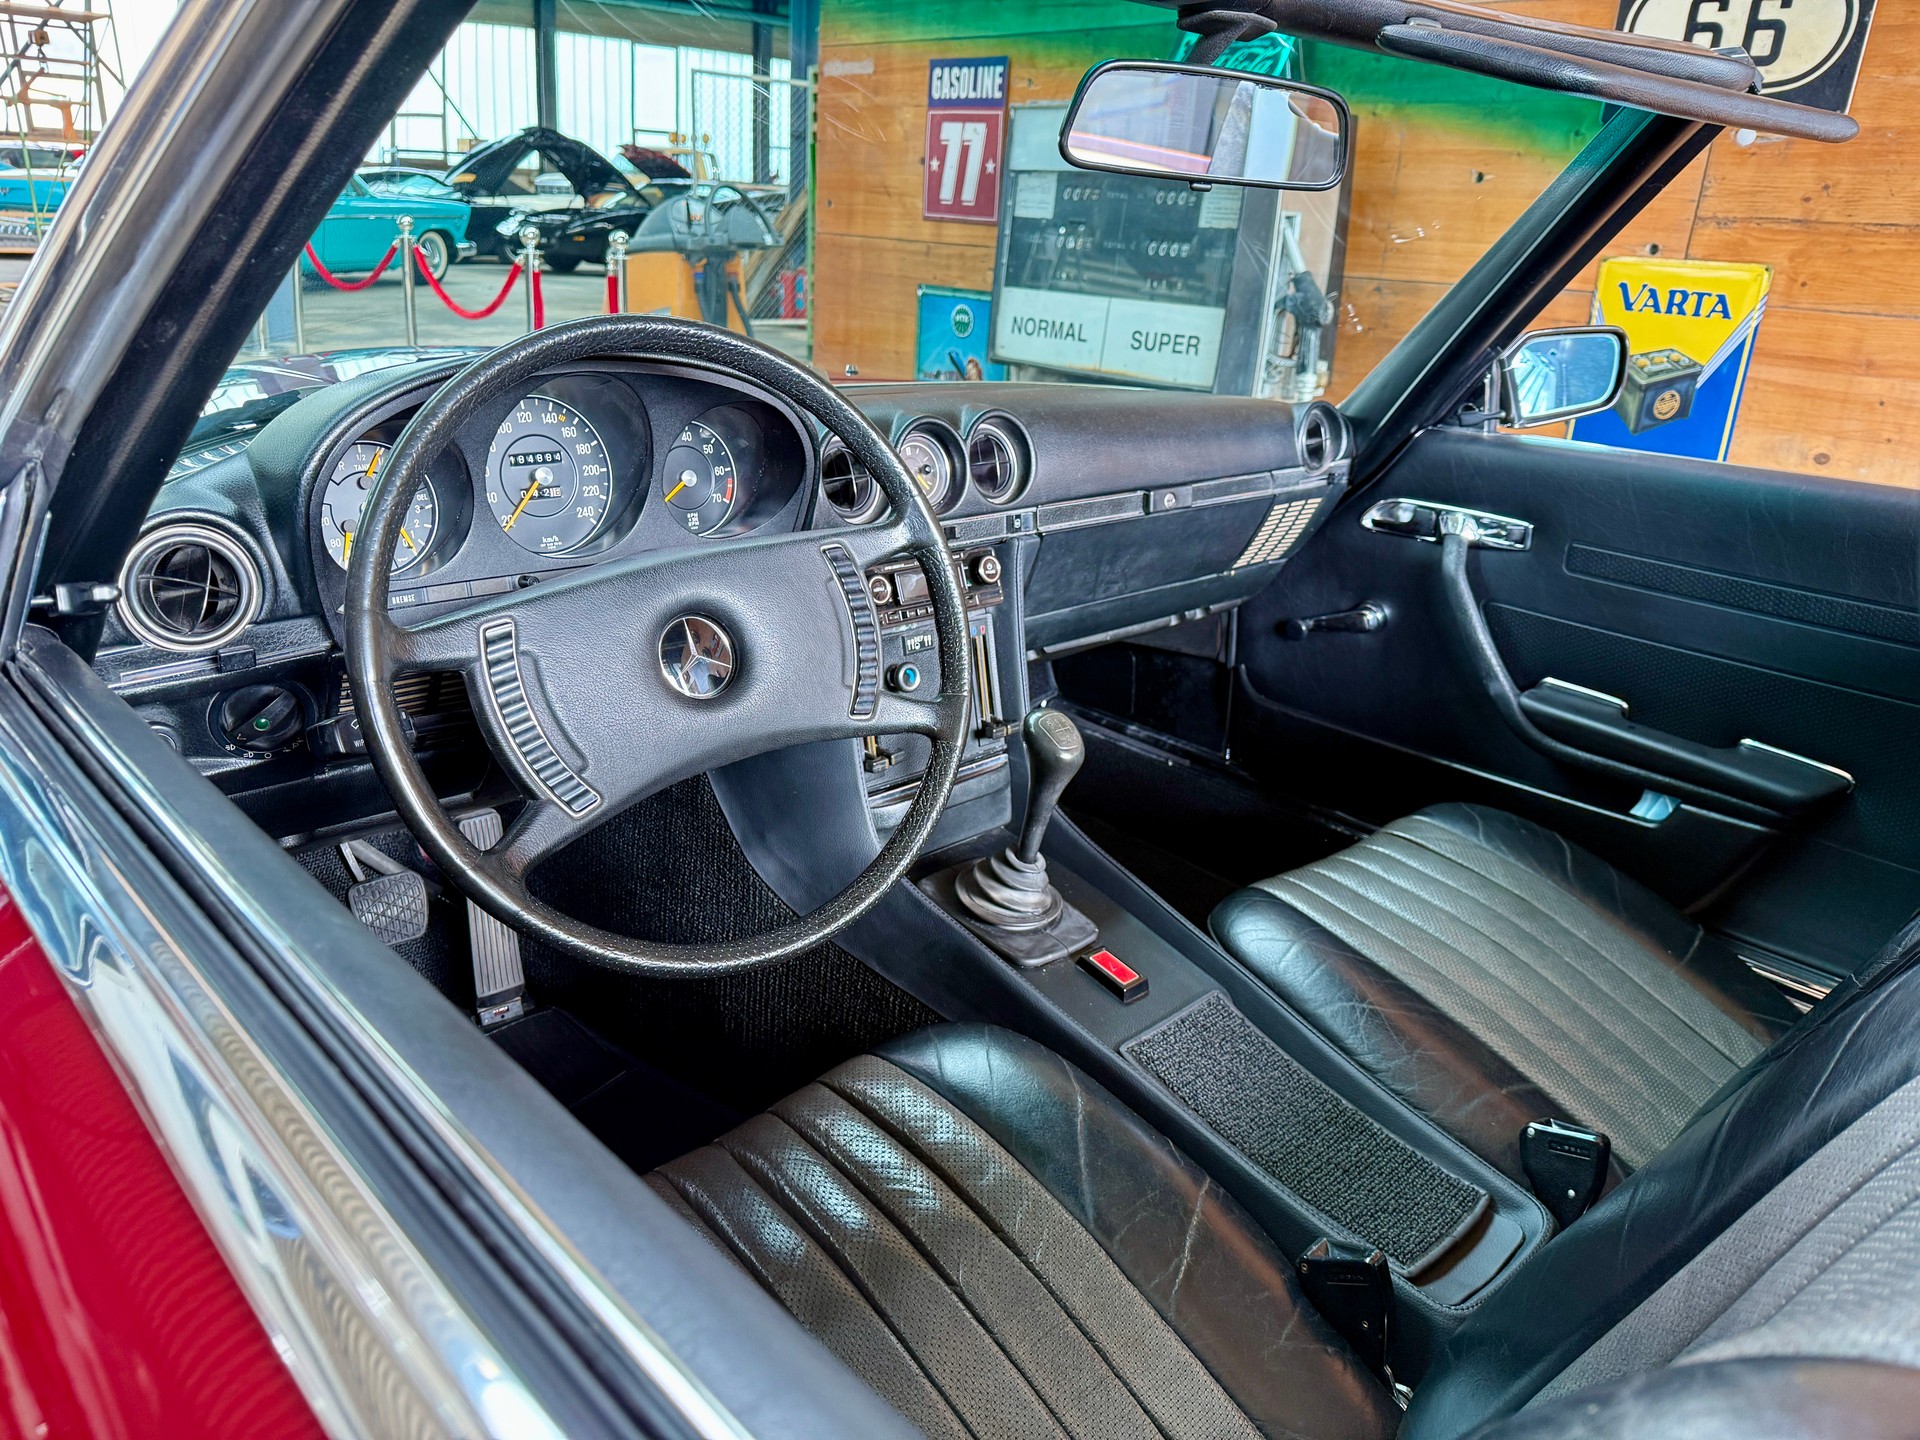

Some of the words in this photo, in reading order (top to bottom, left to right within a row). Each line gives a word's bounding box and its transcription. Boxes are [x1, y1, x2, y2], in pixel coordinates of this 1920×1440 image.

[1685, 0, 1787, 67] 66
[931, 65, 1005, 100] GASOLINE
[939, 121, 988, 206] 11
[1618, 281, 1732, 319] VARTA
[1011, 316, 1088, 343] NORMAL
[1130, 330, 1201, 356] SUPER
[516, 411, 532, 423] 120
[541, 412, 558, 424] 140
[561, 426, 577, 438] 160
[681, 431, 692, 442] 40
[575, 443, 591, 455] 180
[703, 444, 714, 454] 50
[583, 464, 600, 476] 200
[714, 465, 725, 476] 60
[583, 485, 600, 497] 220
[712, 493, 722, 503] 70
[414, 504, 421, 513] 3
[576, 506, 594, 518] 240
[413, 519, 420, 528] 2
[330, 538, 341, 548] 80
